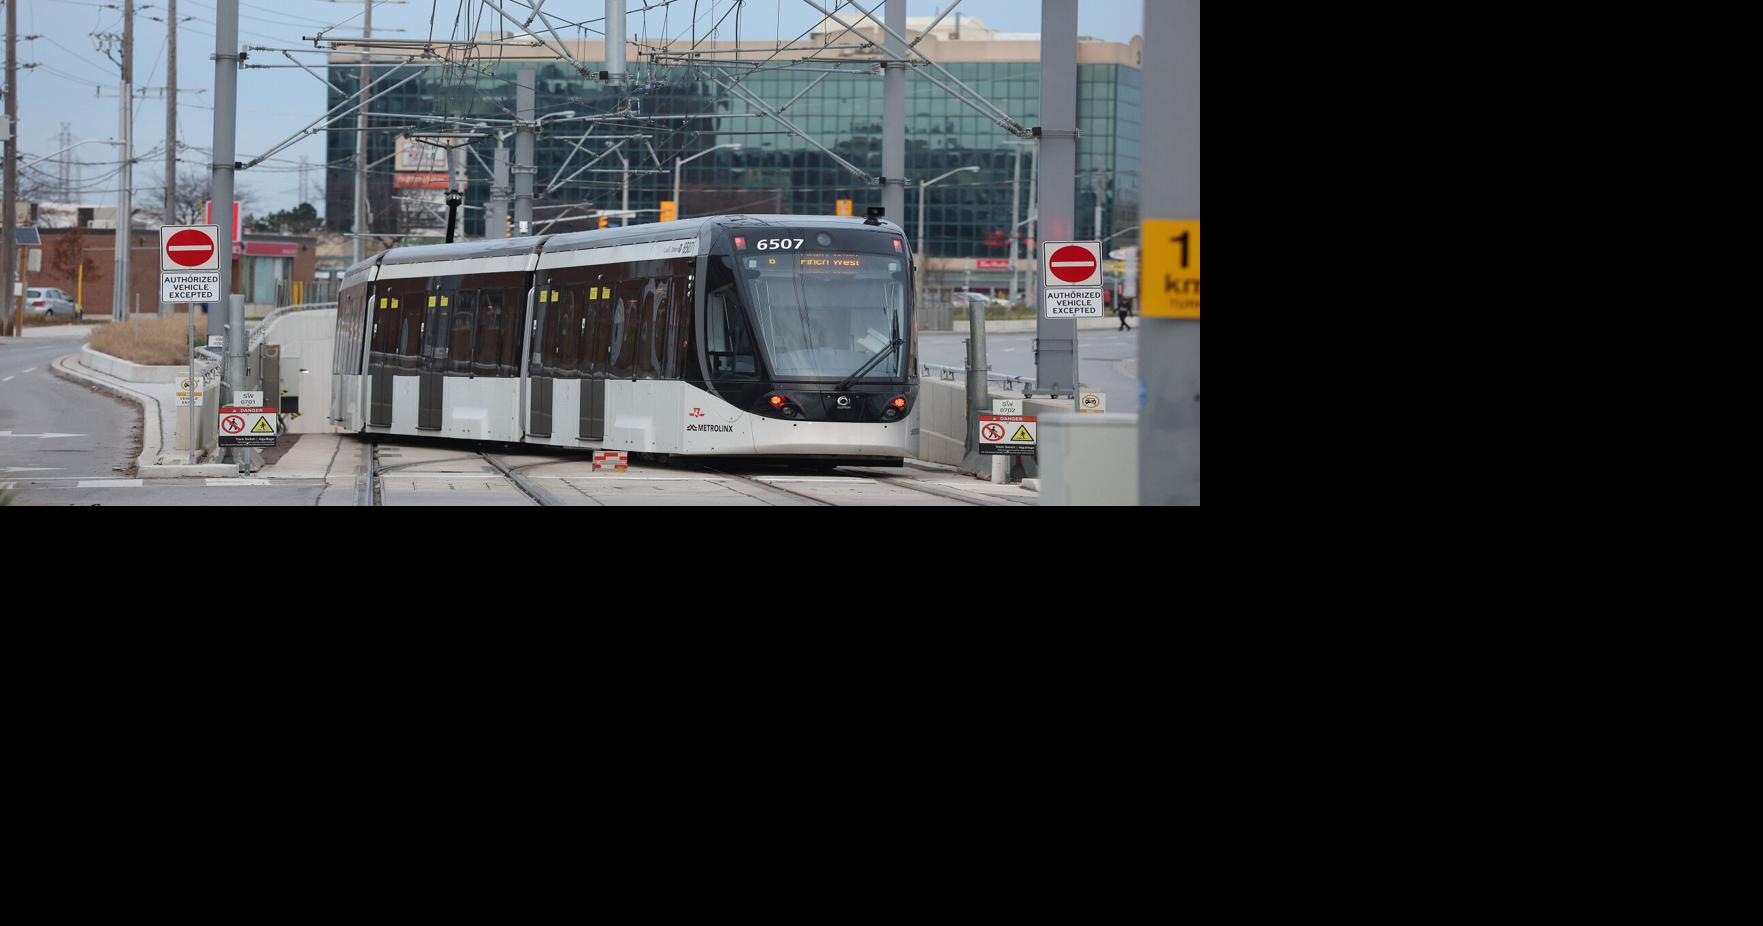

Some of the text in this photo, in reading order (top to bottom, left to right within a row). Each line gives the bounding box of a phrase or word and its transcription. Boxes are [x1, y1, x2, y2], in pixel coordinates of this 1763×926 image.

[756, 238, 805, 251] 6507
[169, 291, 213, 299] EXCEPTED
[1056, 299, 1092, 307] VEHICLE
[697, 424, 733, 432] METROLINX
